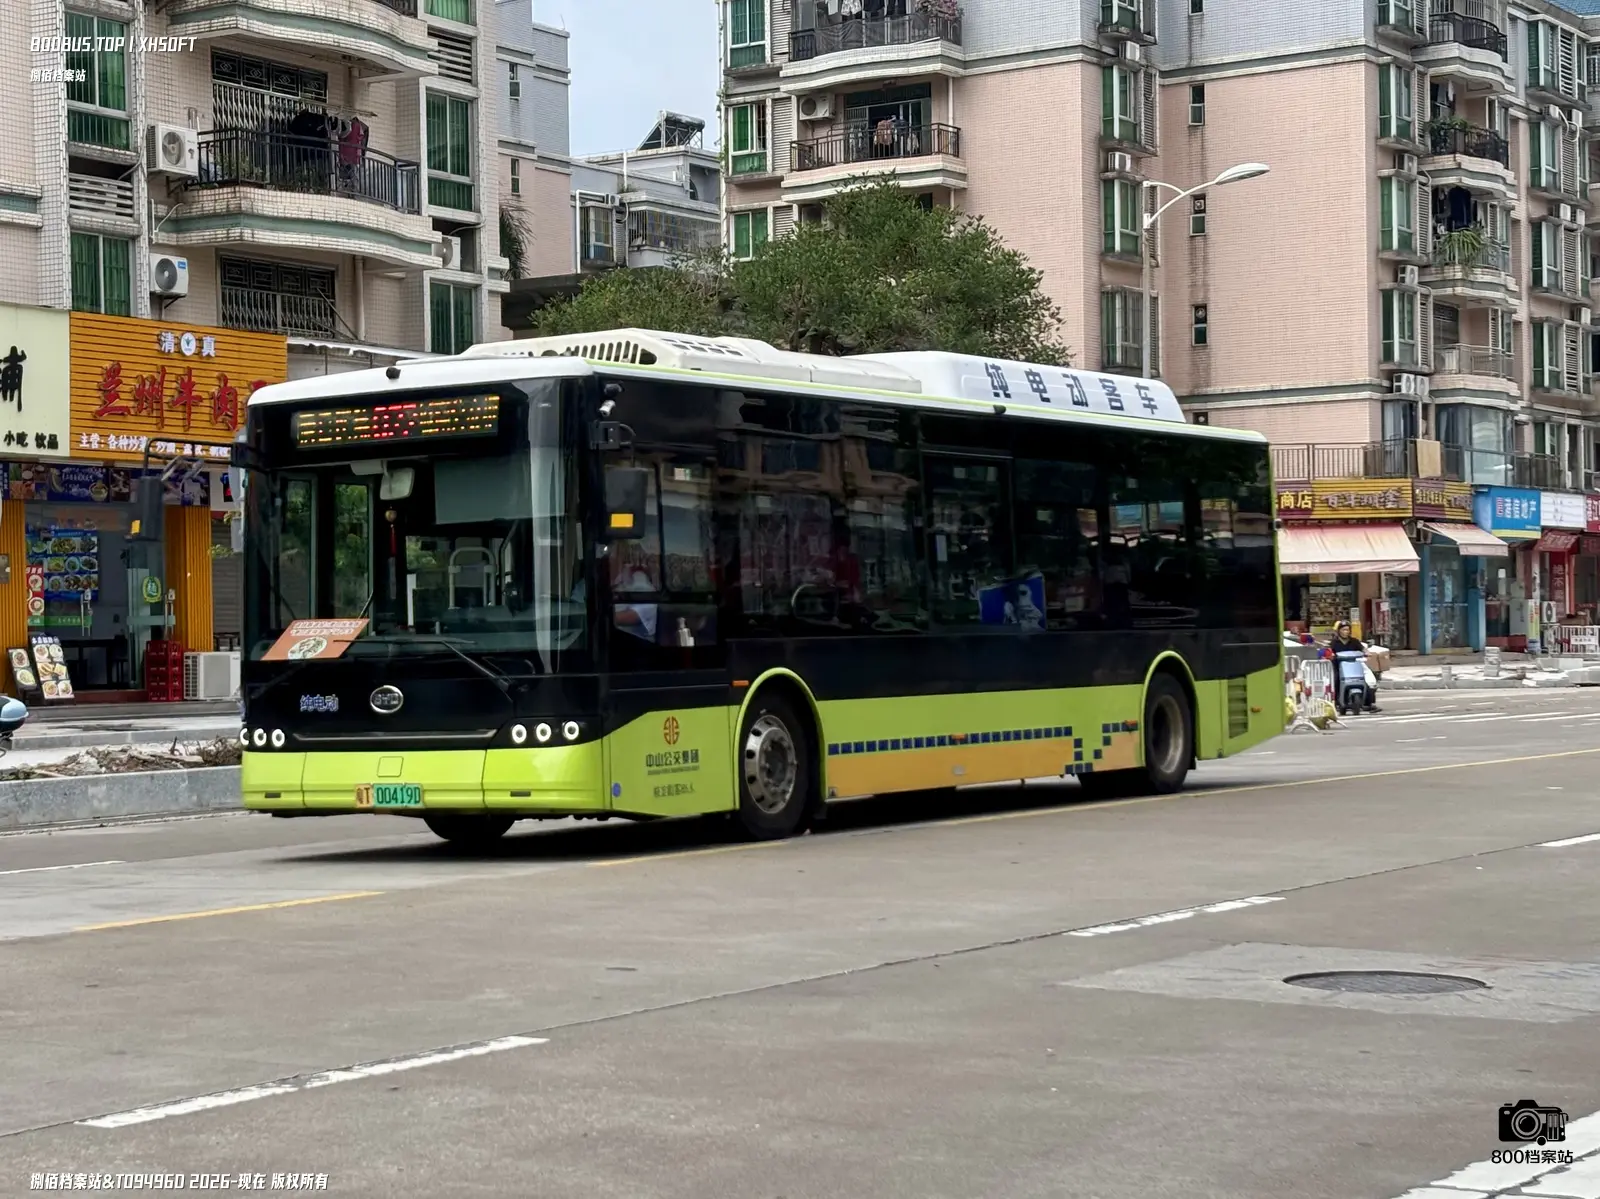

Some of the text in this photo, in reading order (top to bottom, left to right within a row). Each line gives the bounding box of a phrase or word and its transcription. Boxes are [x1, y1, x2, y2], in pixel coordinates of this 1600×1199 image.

[93, 360, 268, 433] 兰州牛肉
[984, 362, 1159, 415] 纯电动客车
[4, 430, 59, 450] 小吃 饮品
[1275, 490, 1313, 509] 商店
[300, 693, 339, 712] 纯电动
[376, 786, 421, 805] 00419D
